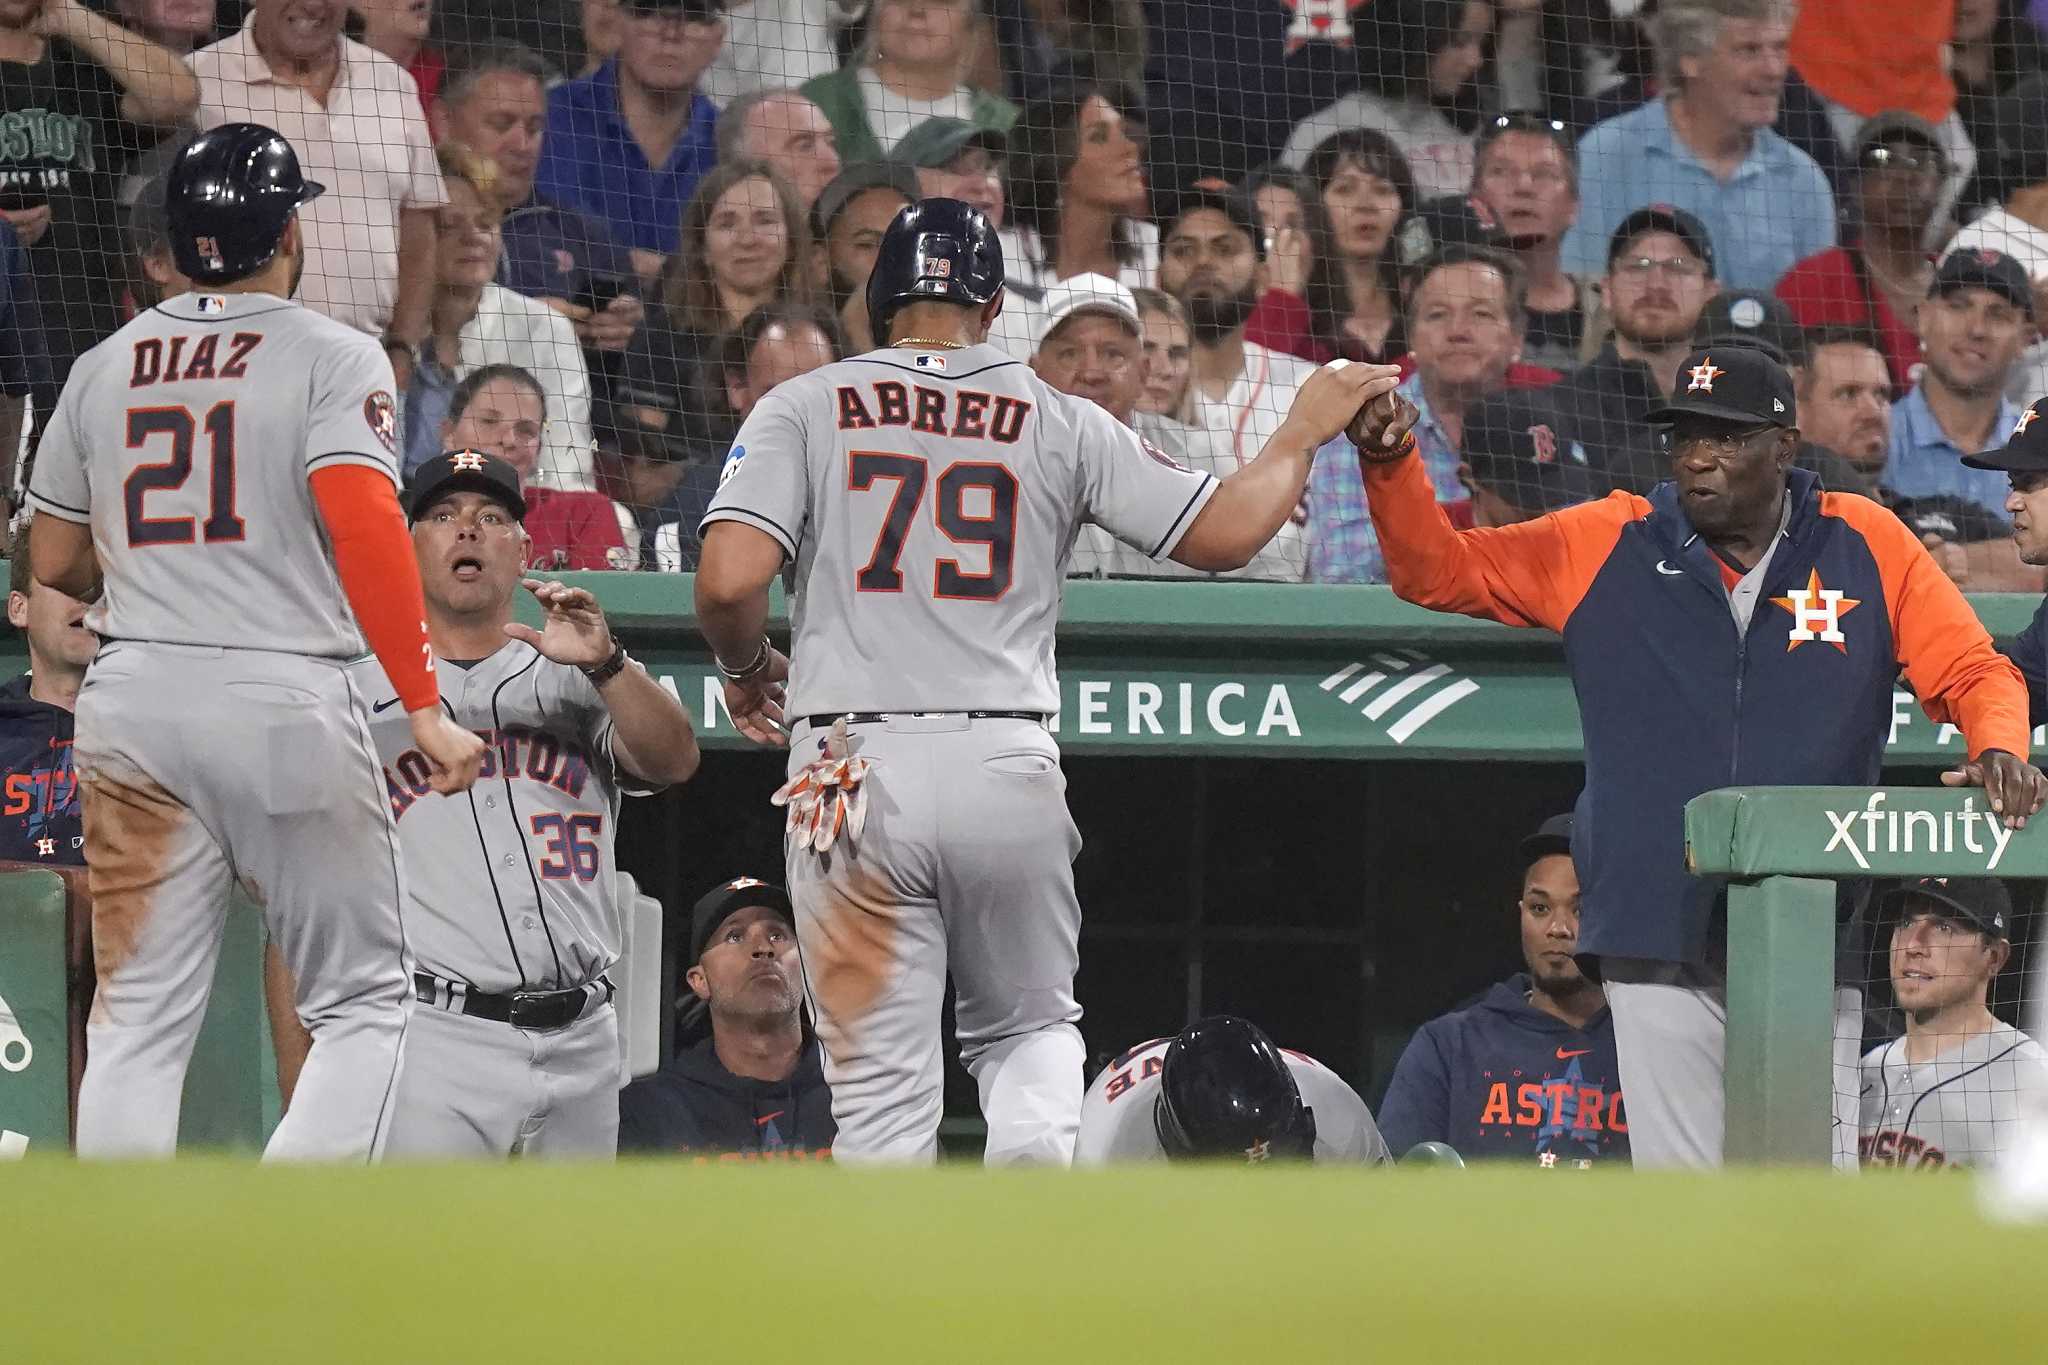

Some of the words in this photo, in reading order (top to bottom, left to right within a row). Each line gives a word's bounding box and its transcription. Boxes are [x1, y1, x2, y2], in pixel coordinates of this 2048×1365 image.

[927, 257, 951, 278] 79
[129, 332, 264, 388] DIAZ
[1687, 365, 1719, 391] H
[836, 380, 1032, 444] ABREU
[123, 400, 246, 549] 21
[847, 450, 1020, 603] 79
[1787, 589, 1846, 643] H
[1050, 680, 1302, 738] ERICA
[529, 813, 603, 883] 36
[1823, 792, 2014, 870] xfinity
